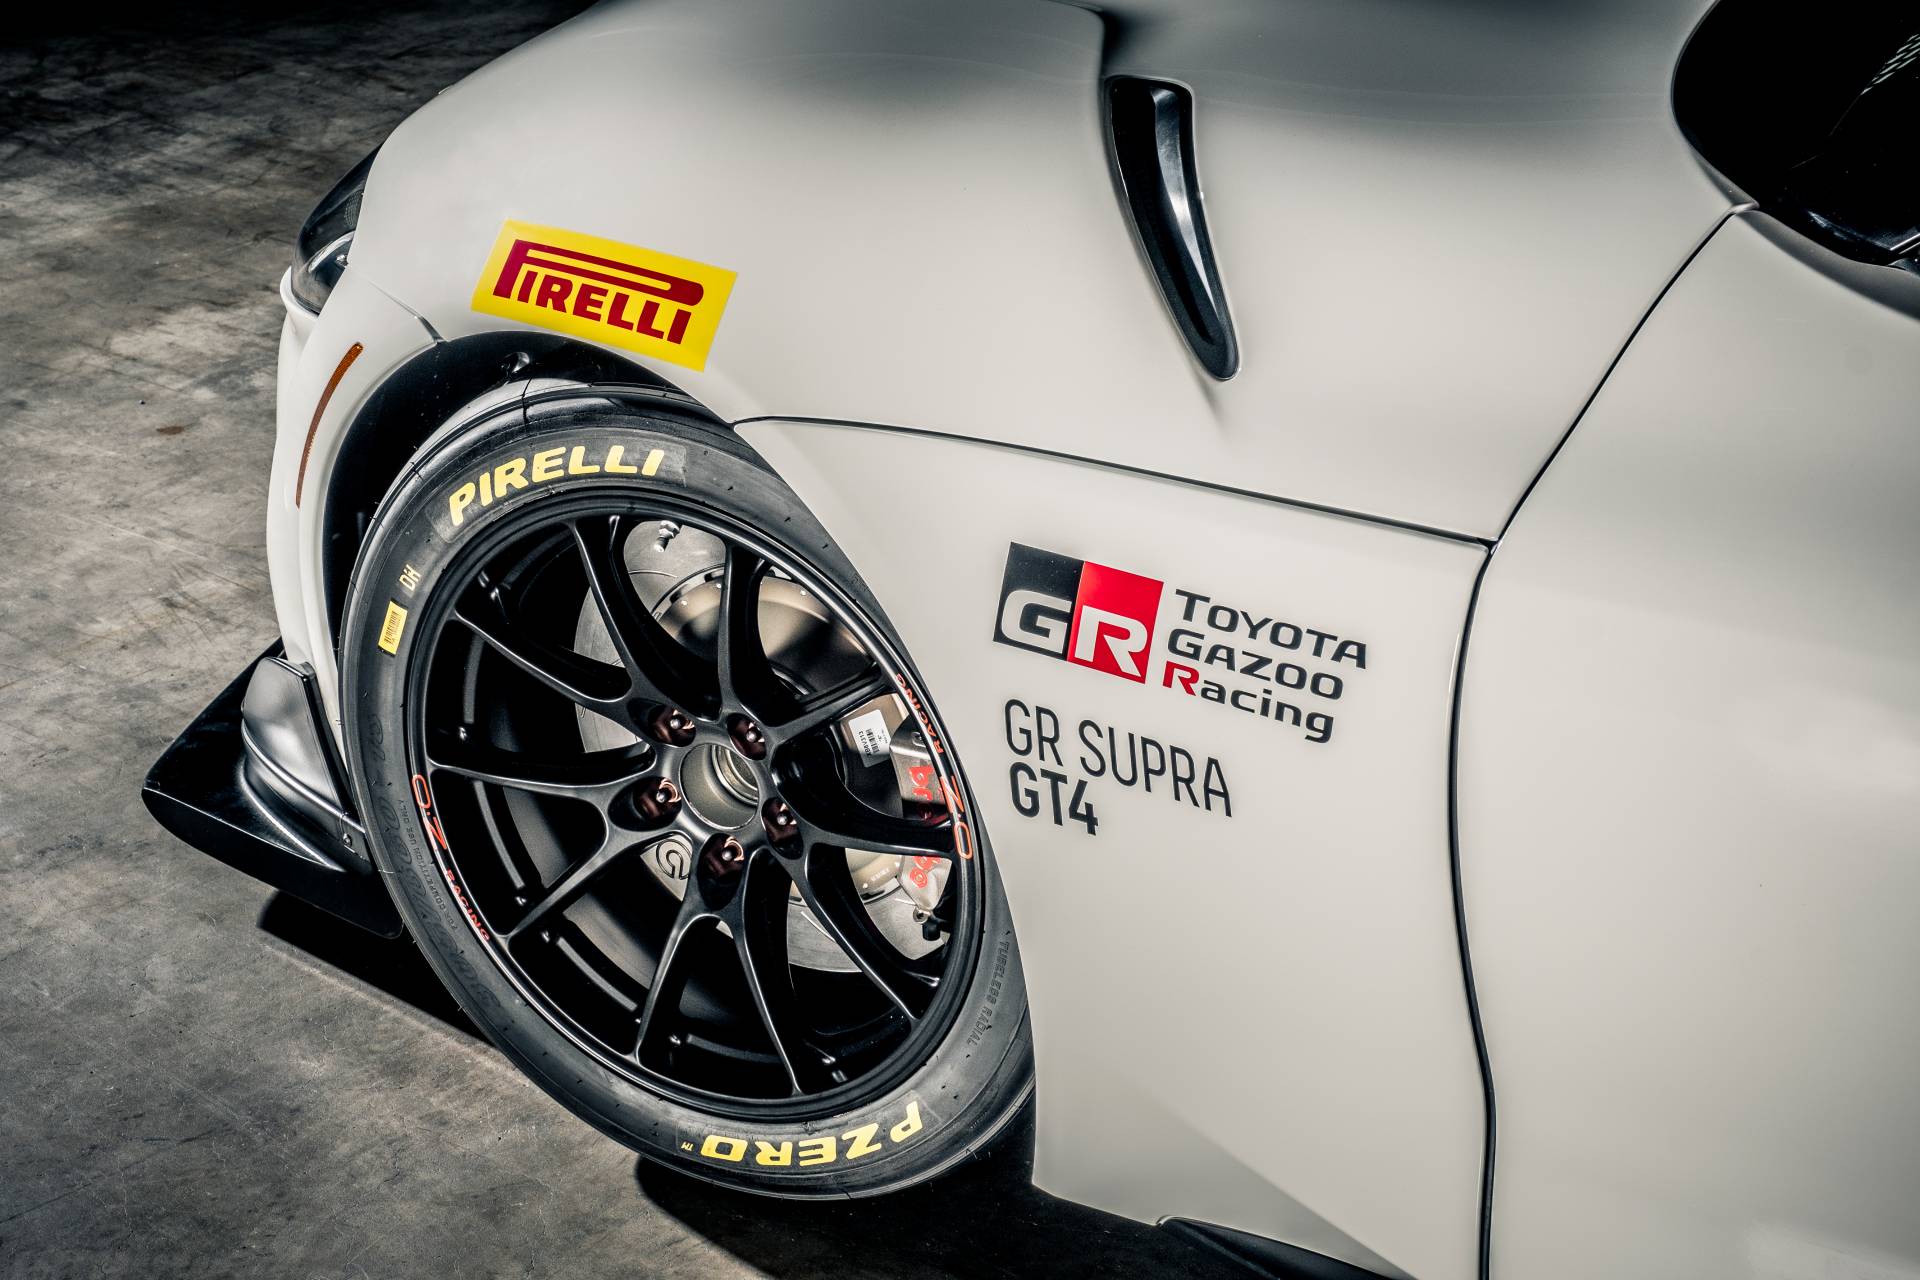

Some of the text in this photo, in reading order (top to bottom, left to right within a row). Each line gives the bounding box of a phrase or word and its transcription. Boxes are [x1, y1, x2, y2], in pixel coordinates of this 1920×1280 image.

[493, 239, 704, 344] PIRELLI
[449, 445, 664, 526] PIRELLI
[998, 588, 1150, 680] GR
[1167, 628, 1344, 700] GAZOO
[1175, 588, 1368, 669] TOYOTA
[896, 673, 944, 754] RACING
[1162, 660, 1334, 744] Racing
[1004, 698, 1233, 818] GR SUPRA
[1010, 761, 1099, 836] GT4
[446, 868, 490, 942] RACING
[700, 1100, 924, 1167] PZERO
